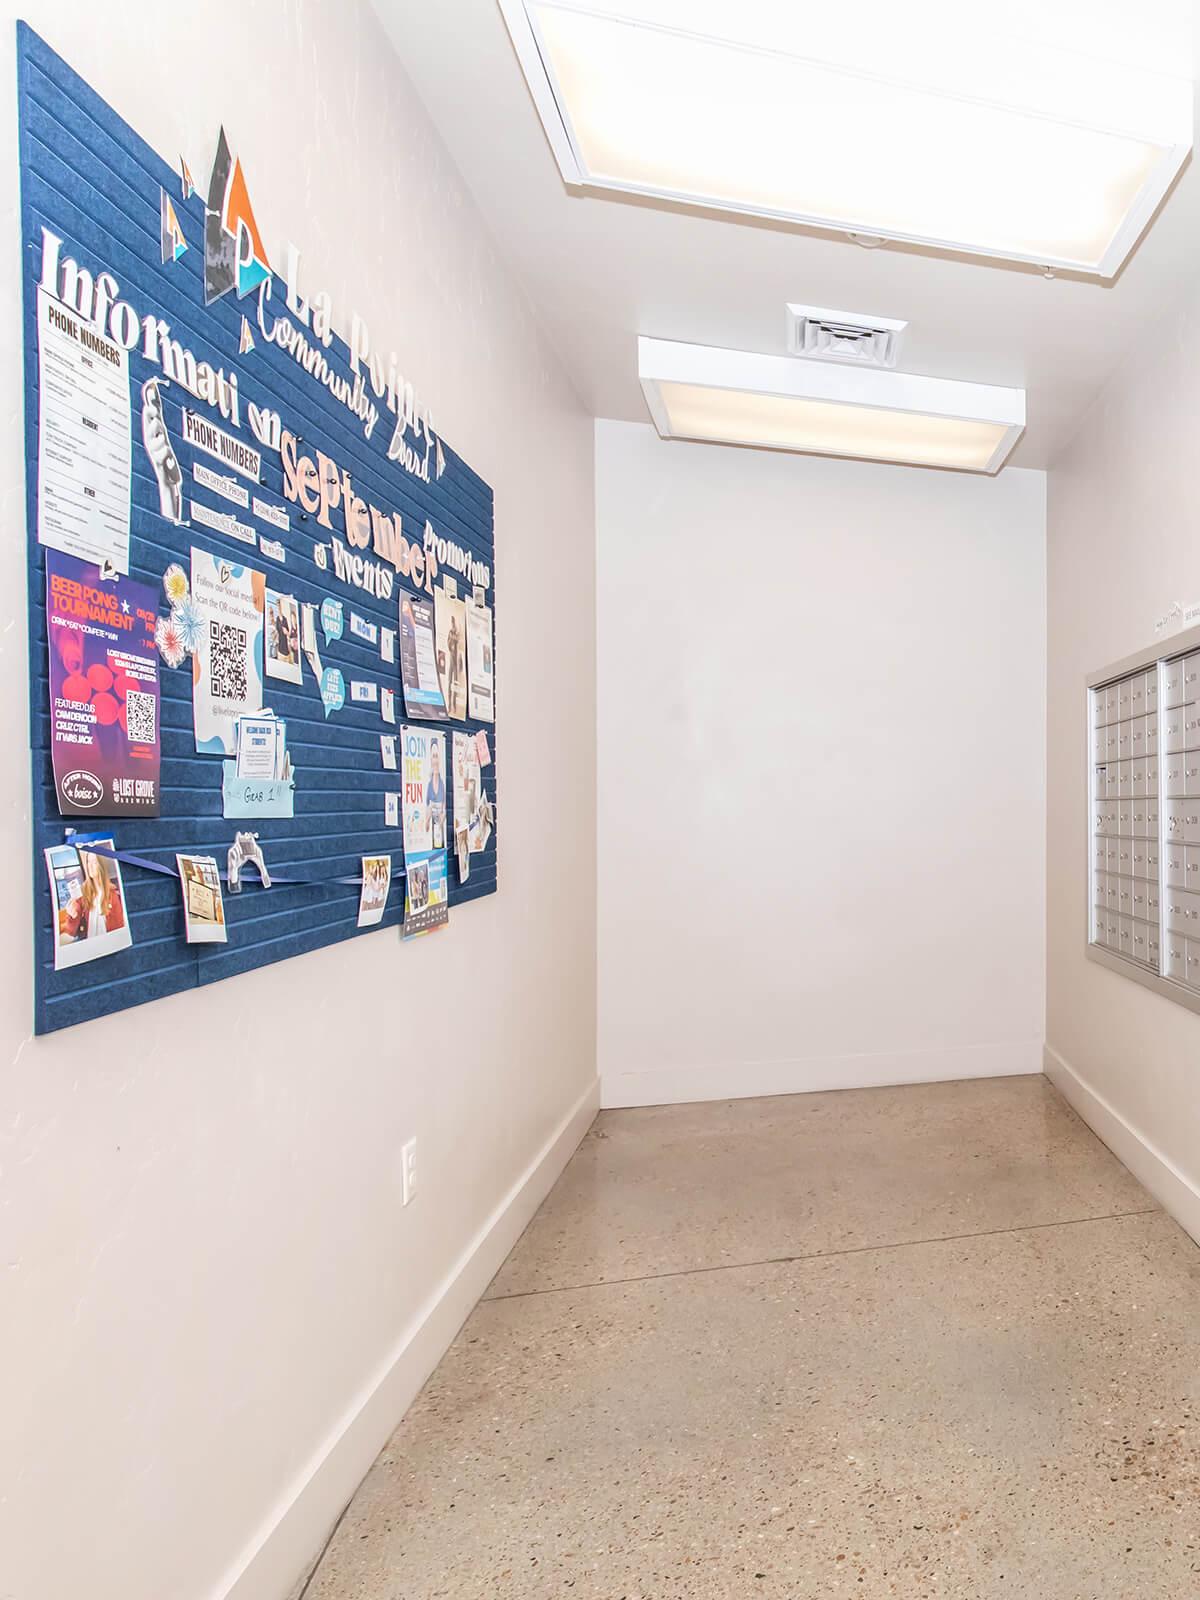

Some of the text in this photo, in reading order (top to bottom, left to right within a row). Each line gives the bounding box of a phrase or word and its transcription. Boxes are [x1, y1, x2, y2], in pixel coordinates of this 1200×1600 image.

[285, 240, 333, 349] La
[48, 306, 79, 341] PHONE
[80, 326, 121, 368] NUMBERS
[257, 276, 381, 440] Community
[187, 416, 259, 476] PHONE NUMBERS
[387, 416, 431, 484] Board
[210, 473, 228, 491] OFFICE
[331, 536, 393, 599] Events
[423, 520, 490, 589] Promotions
[51, 575, 119, 610] BEER PONG
[196, 574, 214, 588] Follow
[51, 592, 134, 631] TOURNAMENT
[195, 592, 241, 617] Scan the QR code
[55, 698, 84, 712] FEATURED
[405, 735, 426, 758] JOIN
[406, 759, 422, 782] THE
[119, 779, 134, 797] LOST
[135, 780, 155, 798] GROVE
[405, 783, 423, 804] FUN
